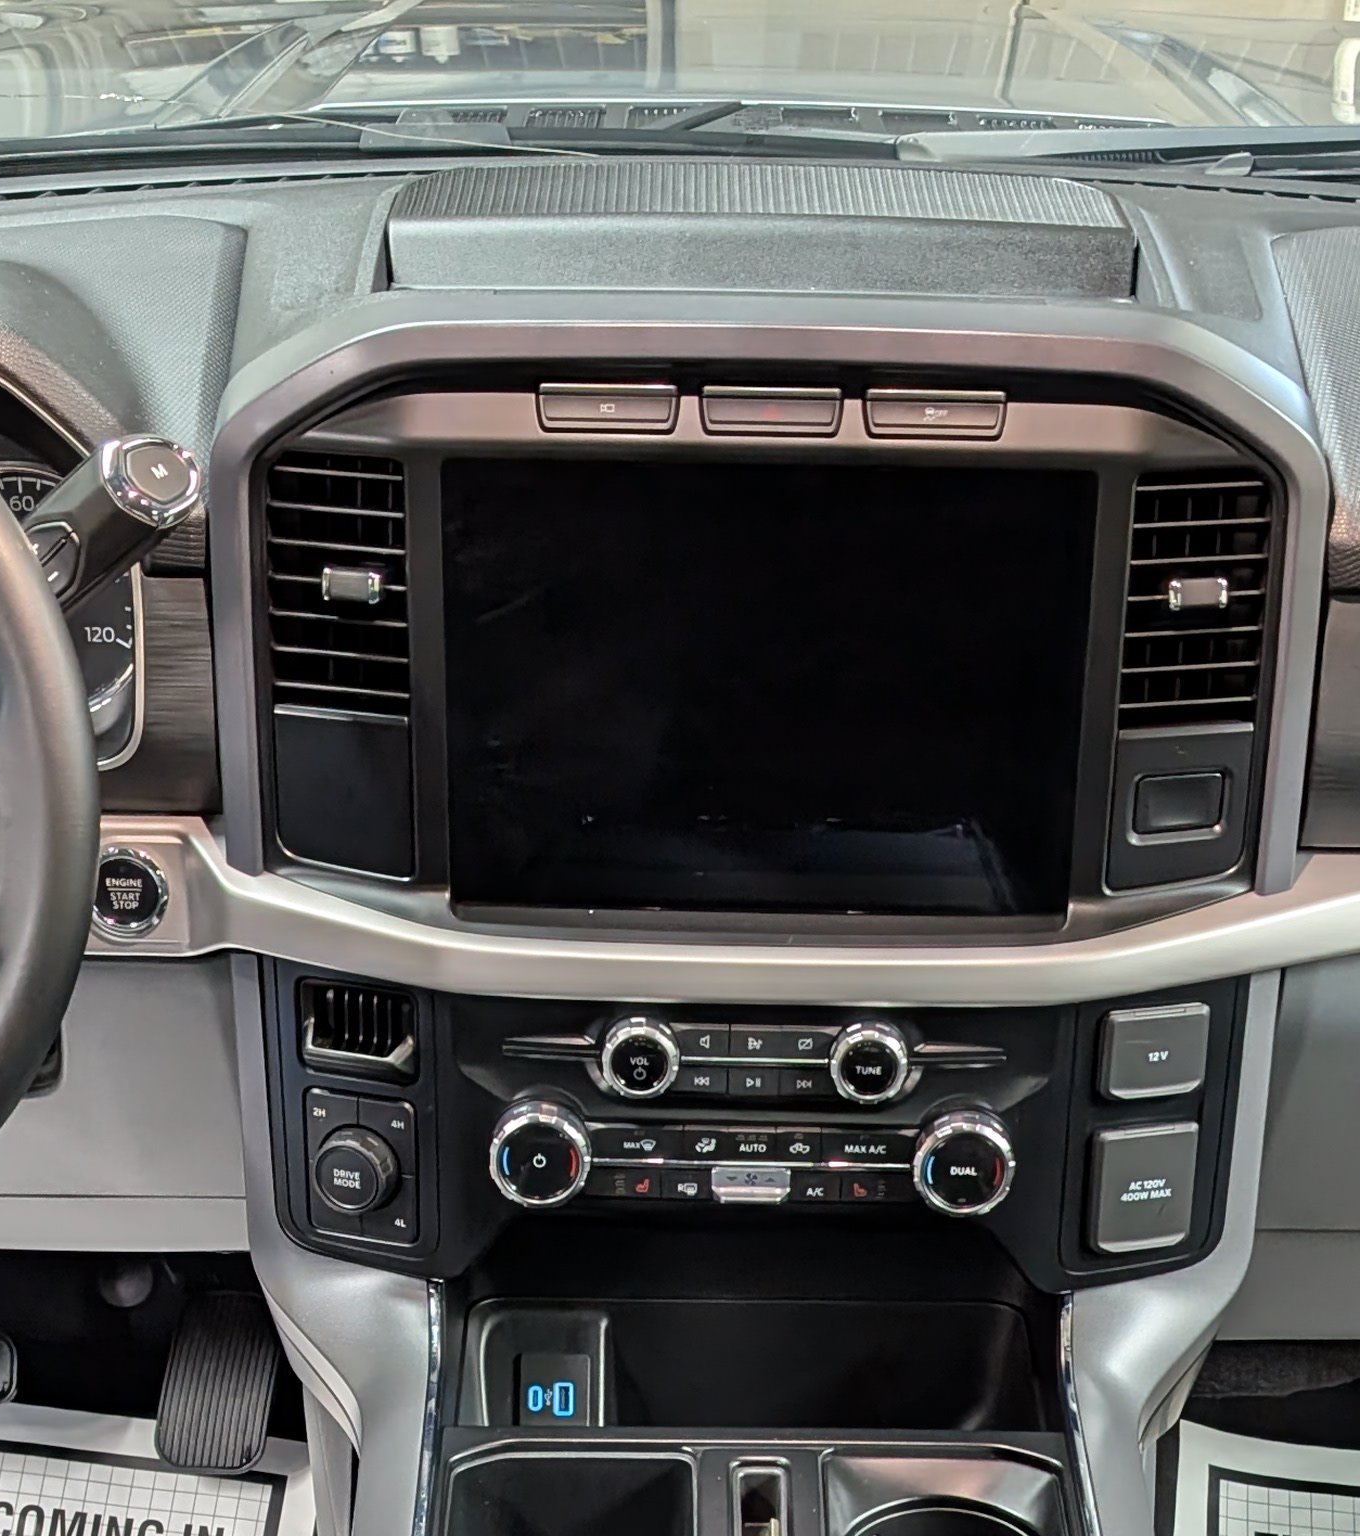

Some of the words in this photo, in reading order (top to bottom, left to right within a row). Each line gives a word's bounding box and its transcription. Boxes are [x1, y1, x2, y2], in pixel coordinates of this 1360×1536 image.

[150, 463, 168, 479] M
[9, 495, 34, 512] 60
[84, 626, 115, 643] 120
[105, 877, 142, 888] ENGINE
[110, 891, 140, 901] START
[112, 901, 140, 910] STOP
[629, 1056, 650, 1066] VOL
[855, 1066, 882, 1076] TUNE
[312, 1107, 326, 1118] 2H
[390, 1120, 404, 1130] 4H
[623, 1141, 640, 1150] MAX
[739, 1143, 767, 1153] AUTO
[844, 1144, 867, 1154] MAX
[869, 1145, 887, 1155] A/C
[333, 1168, 360, 1180] DRIVE
[950, 1166, 977, 1177] DUAL
[333, 1178, 361, 1189] MODE
[1129, 1181, 1142, 1191] AC
[1143, 1178, 1166, 1189] 120V
[806, 1187, 824, 1197] A/C
[1120, 1191, 1149, 1202] 400W
[1150, 1188, 1171, 1199] MAX
[394, 1218, 406, 1228] 4L
